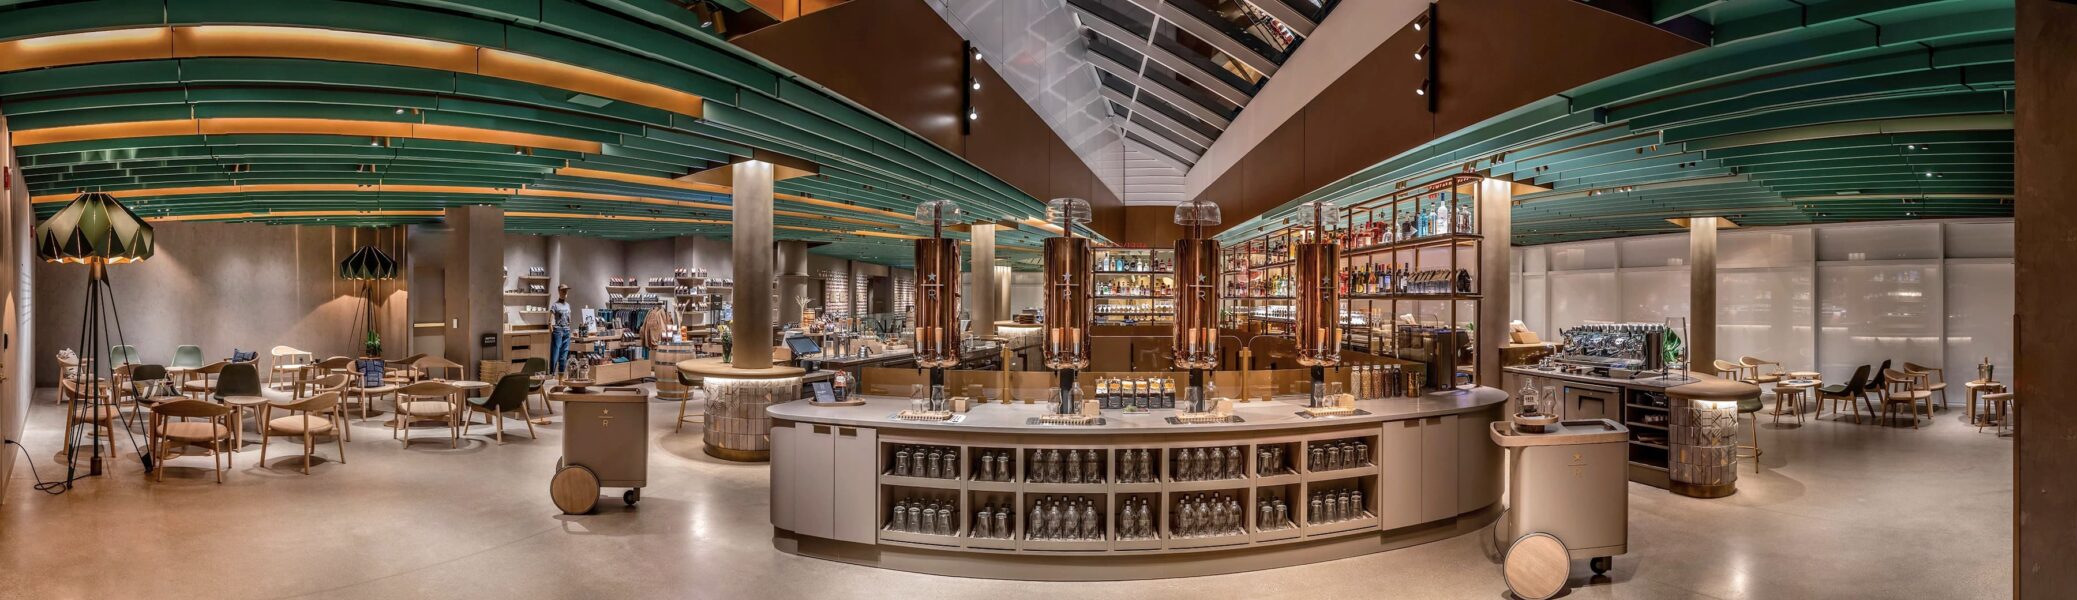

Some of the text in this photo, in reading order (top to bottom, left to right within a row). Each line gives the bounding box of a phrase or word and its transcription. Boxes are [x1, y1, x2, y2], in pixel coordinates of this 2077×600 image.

[928, 289, 936, 300] R
[1063, 289, 1071, 300] R
[1197, 290, 1206, 301] R
[602, 419, 609, 427] R
